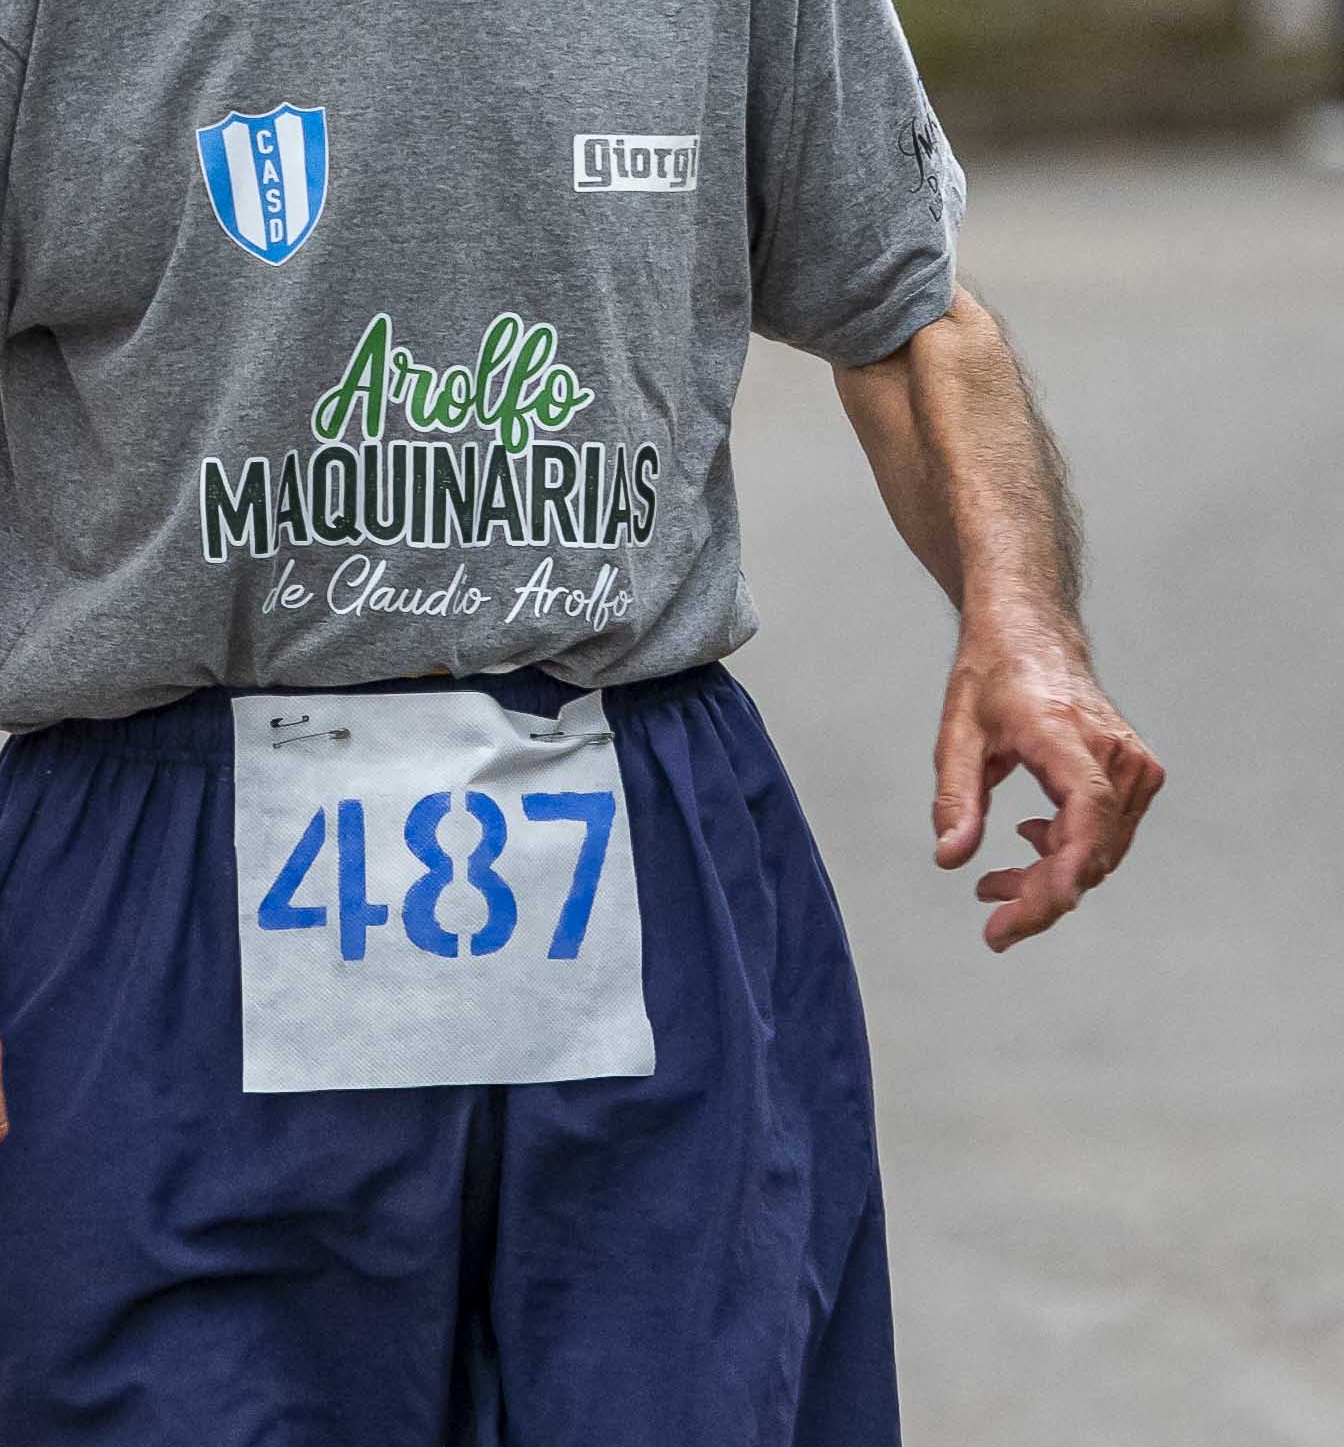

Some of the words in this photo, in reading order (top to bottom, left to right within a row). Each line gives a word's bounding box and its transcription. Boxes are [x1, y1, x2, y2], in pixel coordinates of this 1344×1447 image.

[255, 129, 284, 244] CASD
[577, 138, 698, 189] giorgi
[313, 315, 593, 454] Arolfo
[202, 441, 659, 562] MAQUINARIAS
[262, 558, 315, 615] de
[326, 554, 491, 617] Claudio
[503, 556, 634, 633] Arolfo
[256, 790, 616, 962] 487
